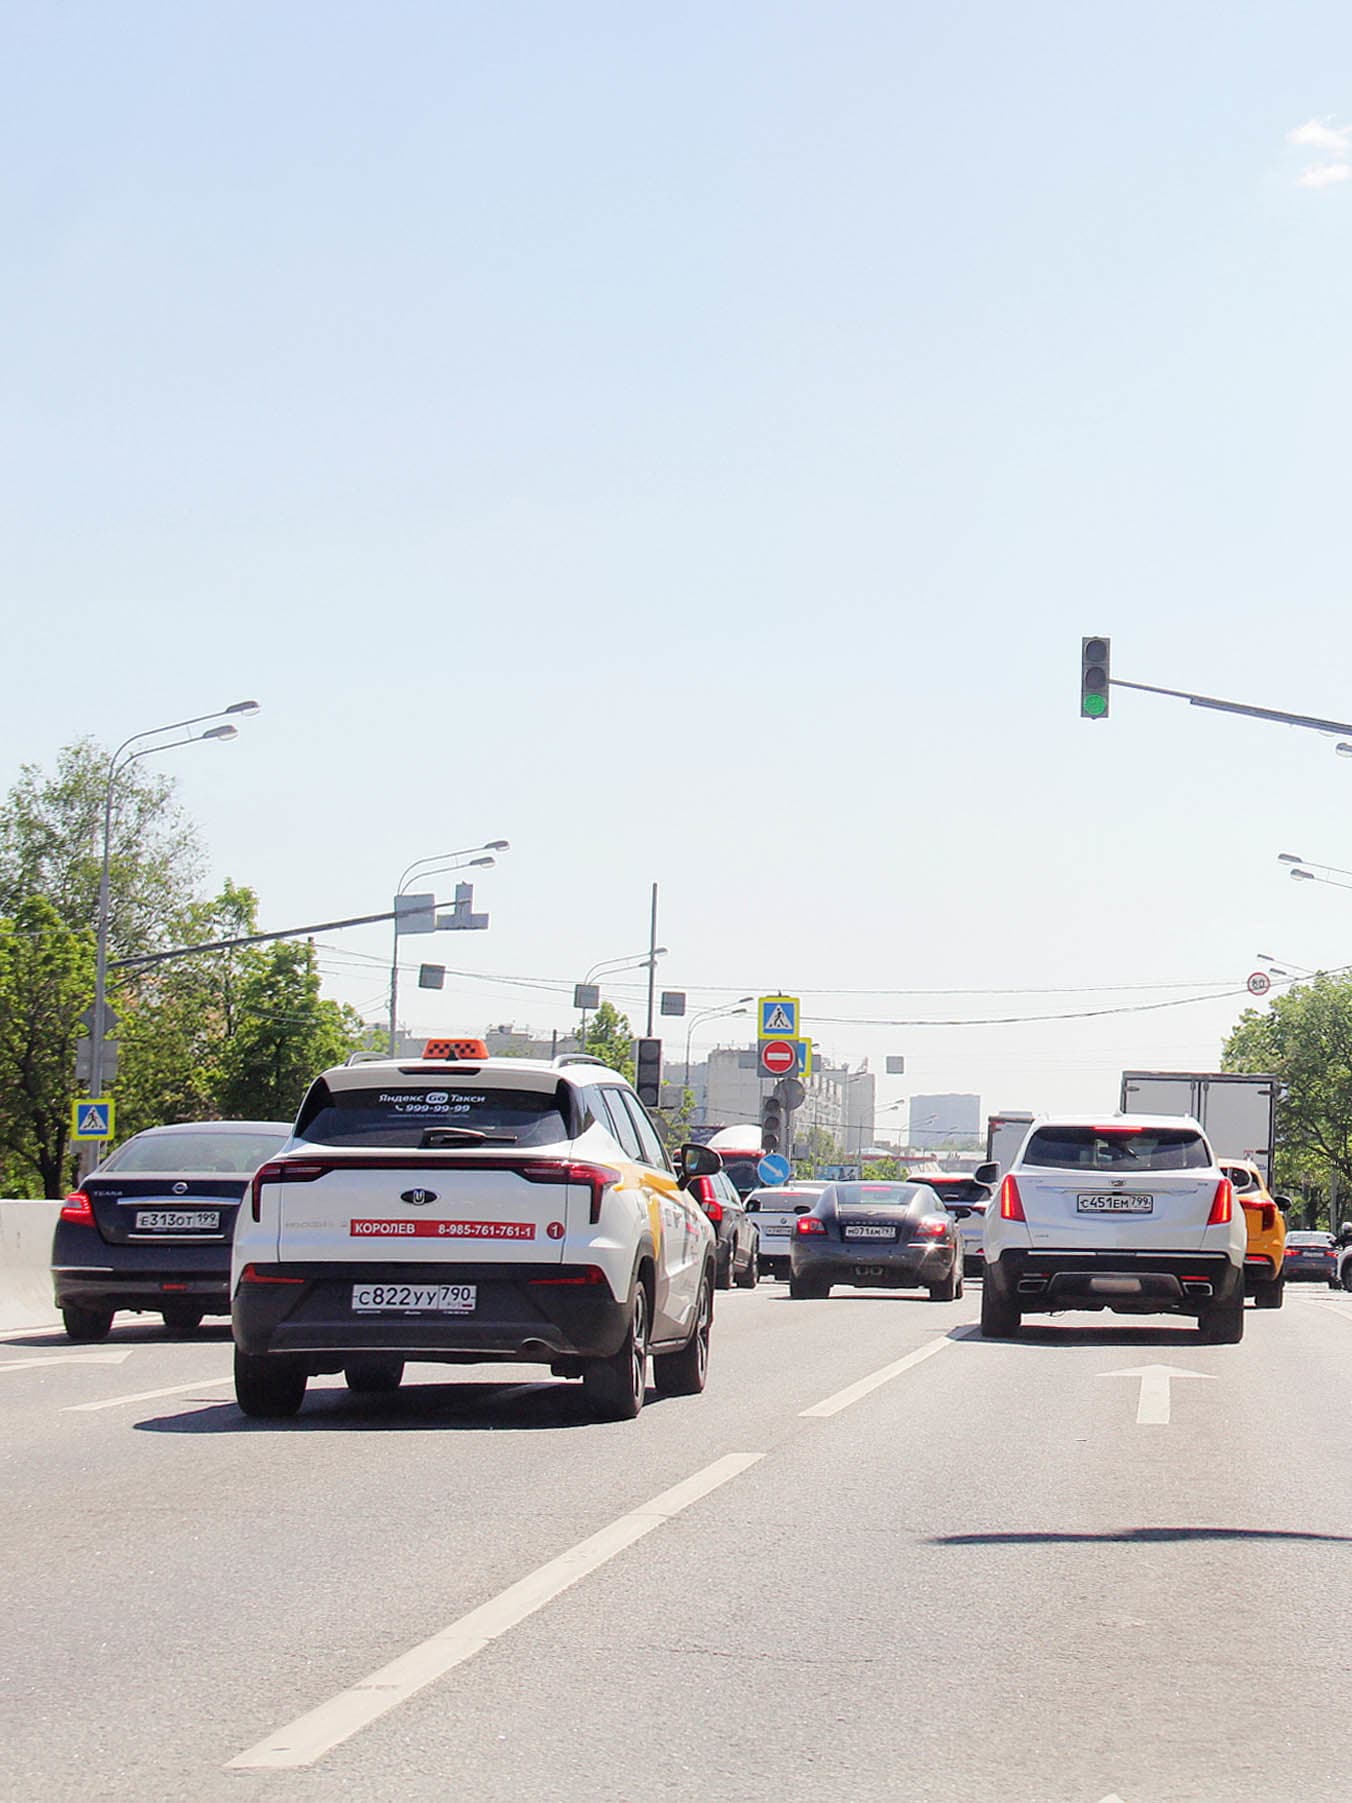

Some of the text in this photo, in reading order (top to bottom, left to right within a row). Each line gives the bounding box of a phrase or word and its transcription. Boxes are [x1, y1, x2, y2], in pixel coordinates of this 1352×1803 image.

[379, 1094, 424, 1103] Яндекс
[450, 1094, 486, 1103] Такси
[405, 1104, 471, 1113] 999-99-99
[355, 1223, 416, 1235] КОРОЛЕВ
[437, 1224, 533, 1237] 8-985-761-761-1
[440, 1287, 471, 1301] 790
